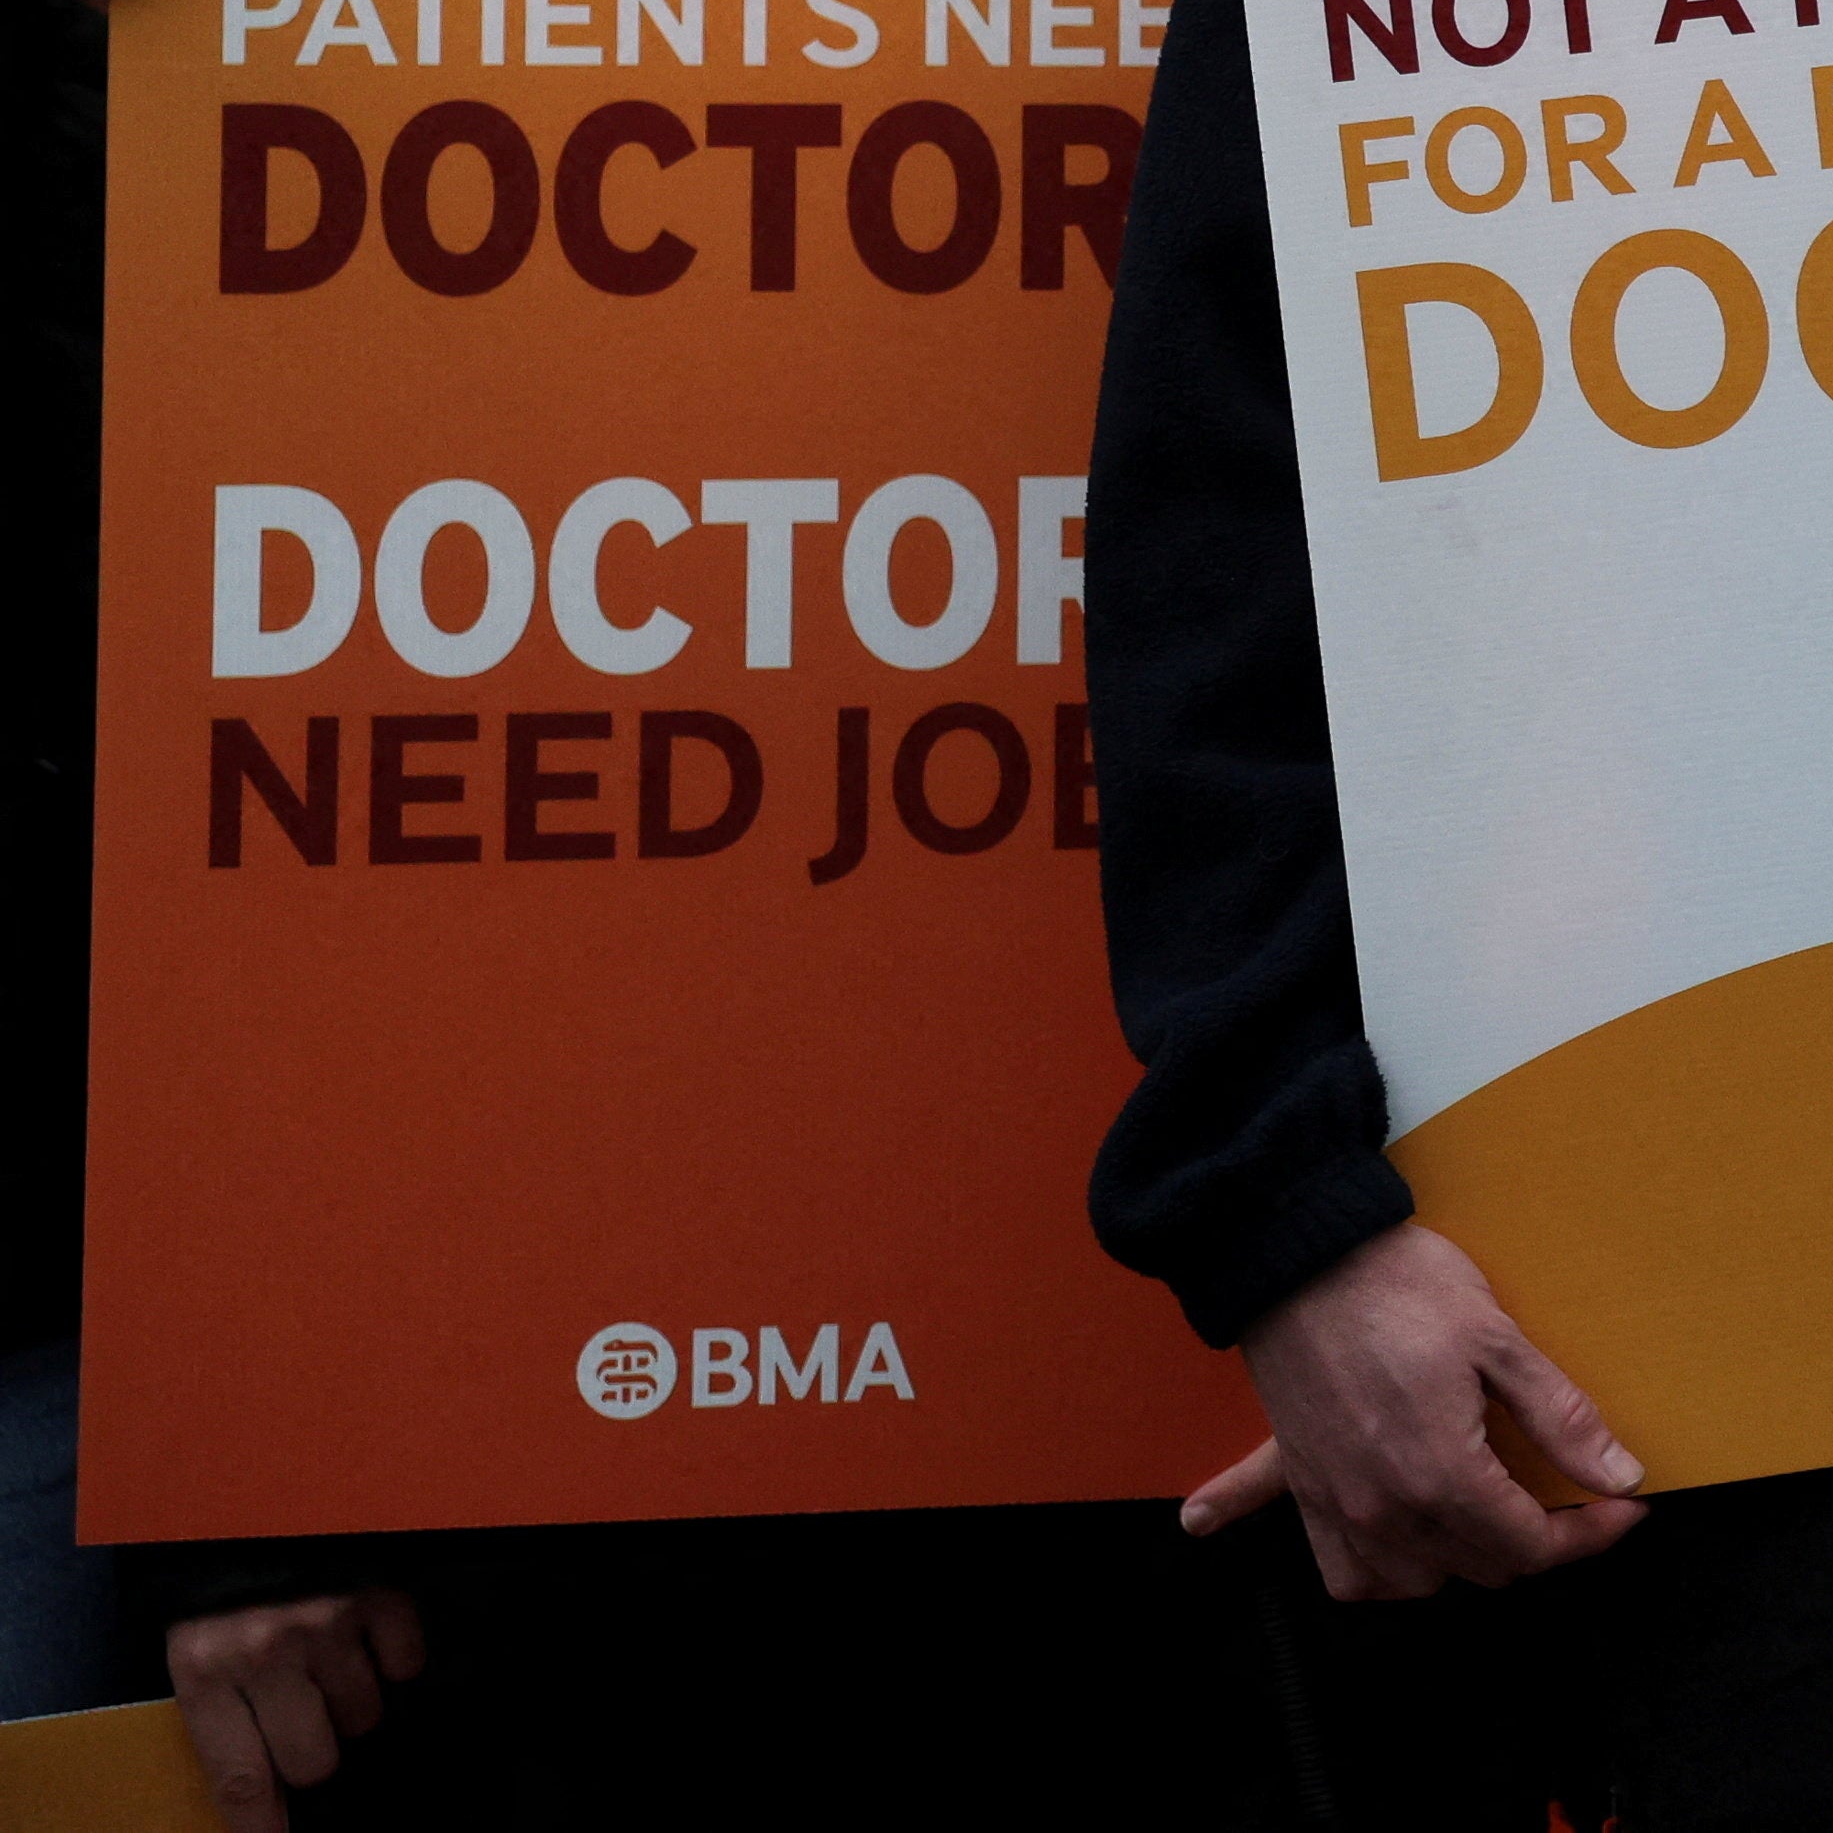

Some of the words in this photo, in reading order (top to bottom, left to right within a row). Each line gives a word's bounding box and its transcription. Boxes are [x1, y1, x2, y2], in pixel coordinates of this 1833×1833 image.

[219, 99, 1147, 298] DOCTOR
[1337, 92, 1637, 228] FOR
[1672, 77, 1778, 187] A
[207, 708, 764, 871] NEED
[691, 1321, 915, 1408] BMA
